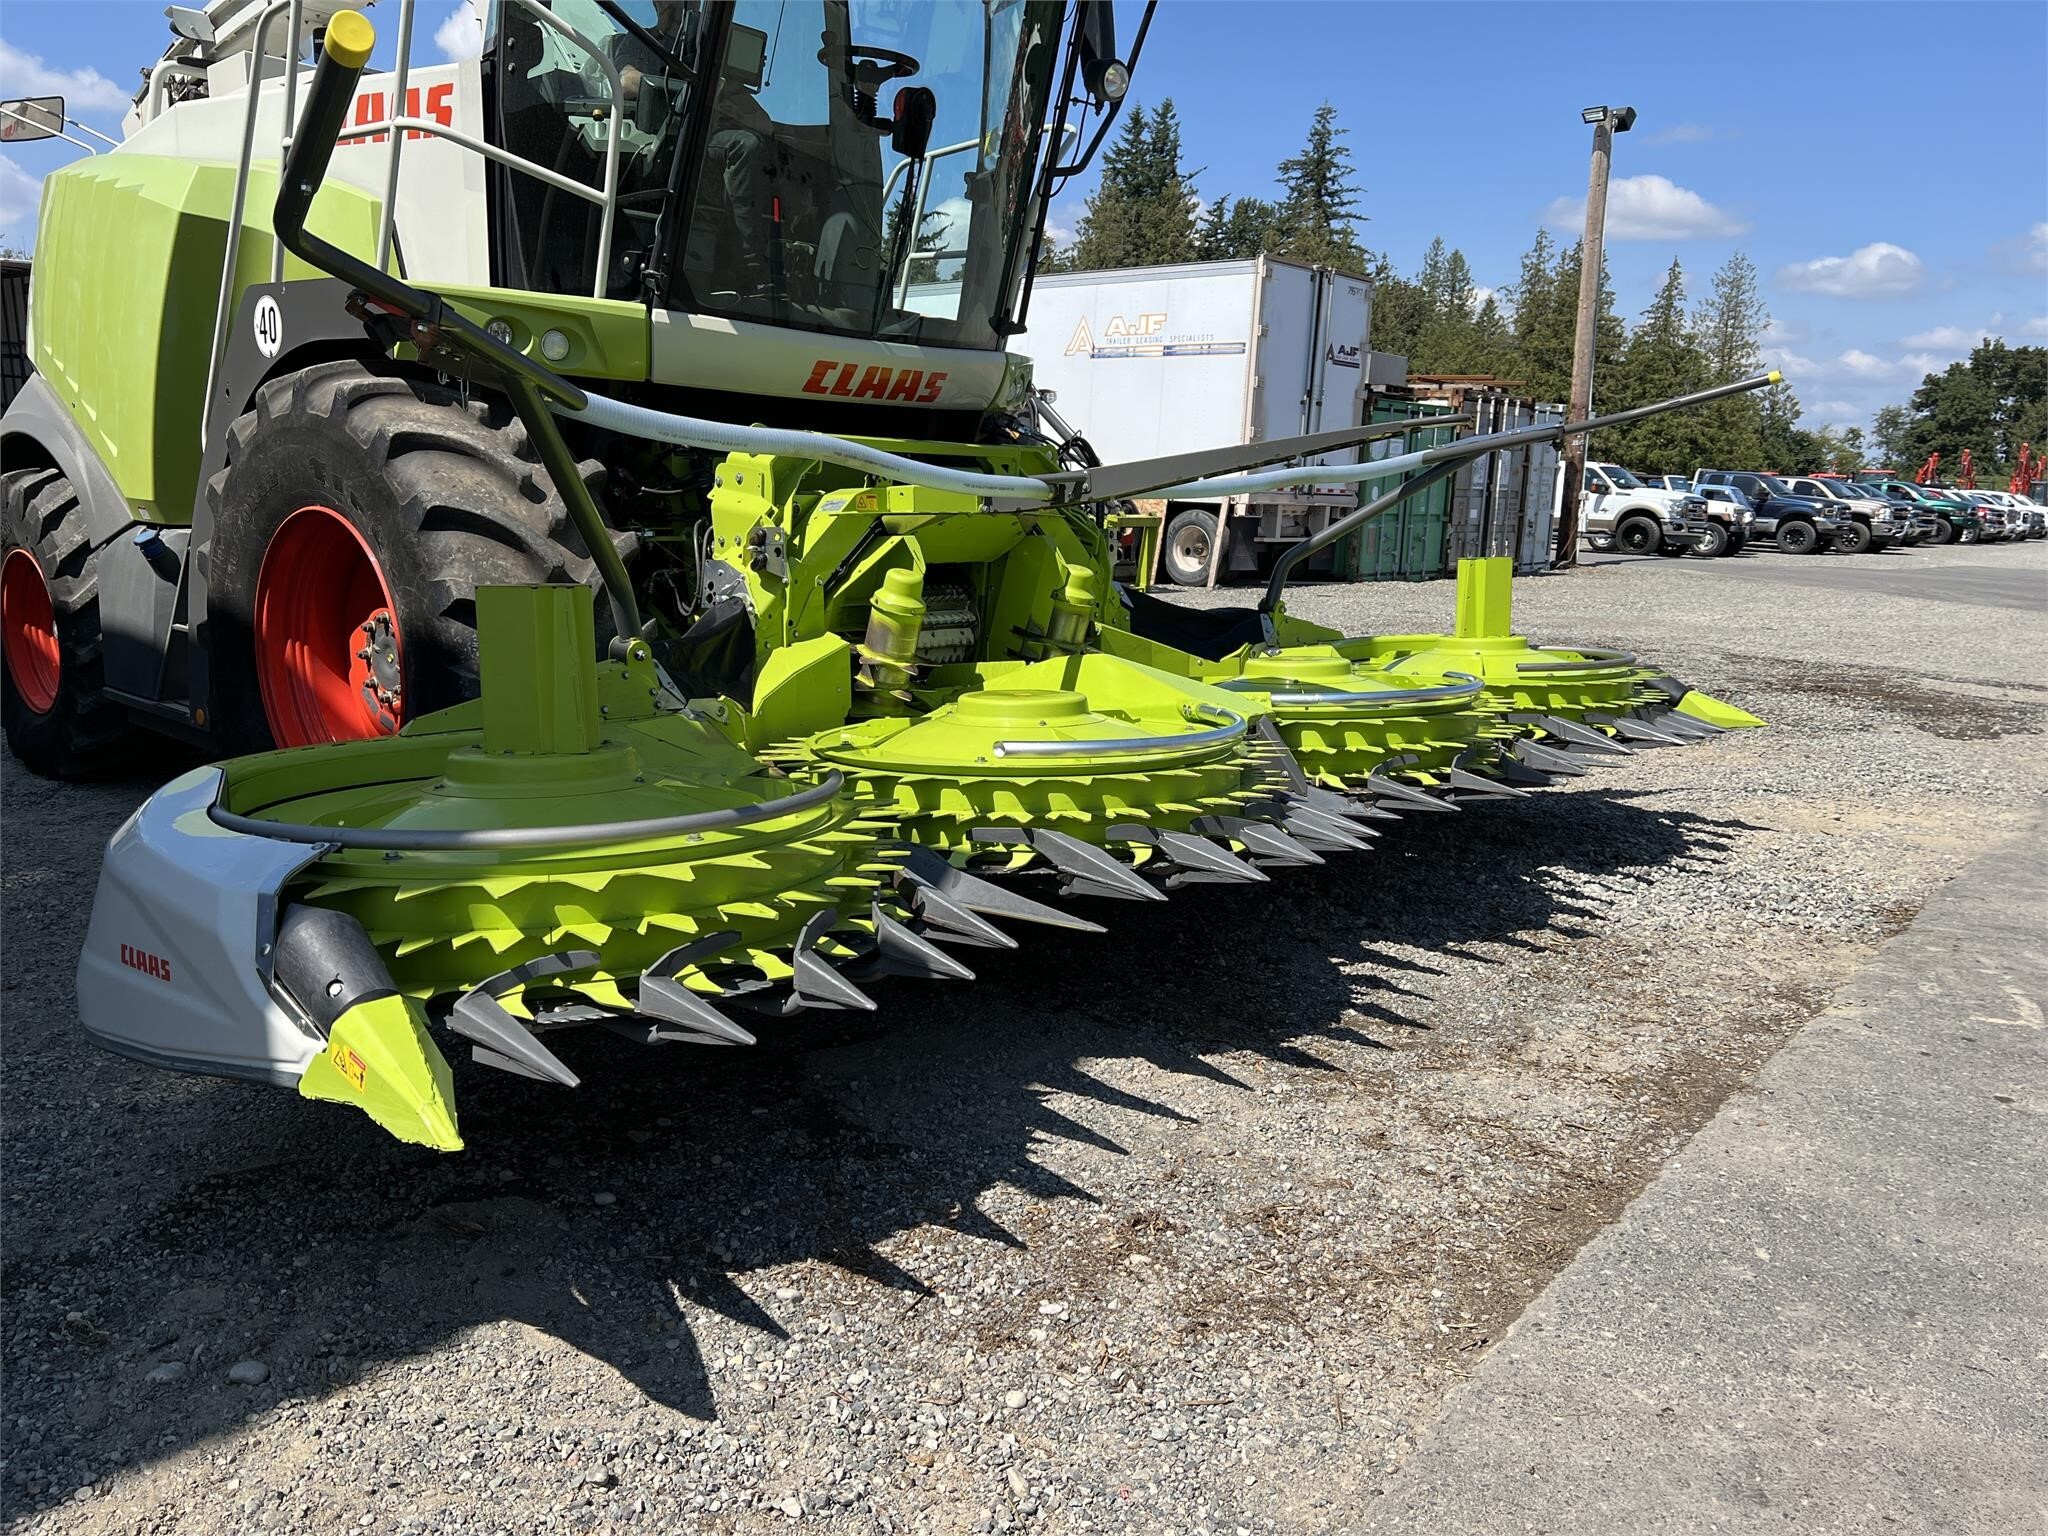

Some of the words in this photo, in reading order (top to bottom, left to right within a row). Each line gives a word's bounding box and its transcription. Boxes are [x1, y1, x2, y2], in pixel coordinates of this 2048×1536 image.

[335, 83, 454, 146] AAS
[259, 306, 277, 344] 40
[1105, 337, 1131, 345] TRAILER
[1136, 336, 1163, 344] LEASING
[1169, 334, 1214, 343] SPECIALISTS
[801, 360, 948, 403] CLAAS
[121, 943, 171, 982] CLAAS
